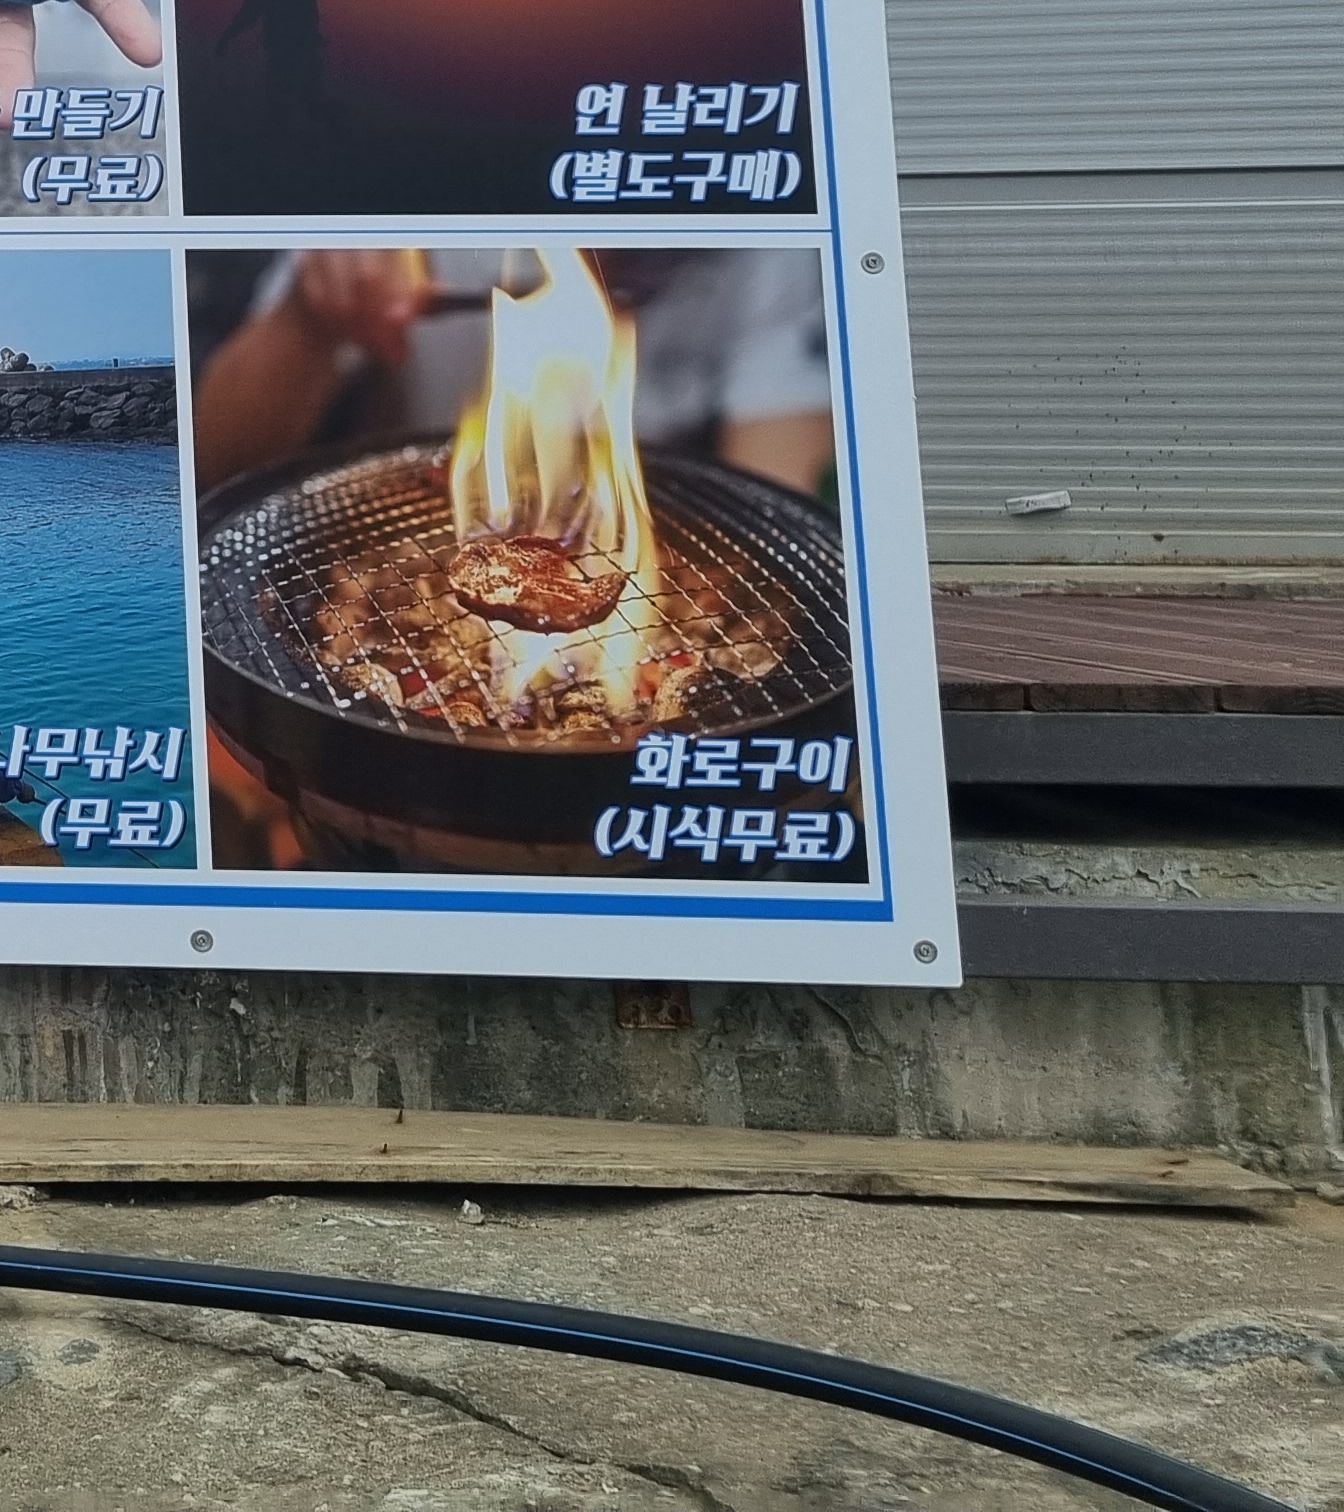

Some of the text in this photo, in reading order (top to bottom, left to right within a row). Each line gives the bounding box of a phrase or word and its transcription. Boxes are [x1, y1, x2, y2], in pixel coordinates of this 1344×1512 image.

[11, 85, 165, 141] 만들기
[575, 80, 801, 135] 연 날리기
[21, 153, 166, 205] (무료)
[549, 147, 802, 202] (별도구매)
[629, 731, 854, 793] 화로구이
[39, 796, 187, 850] (무료)
[594, 803, 856, 863] (시식무료)
